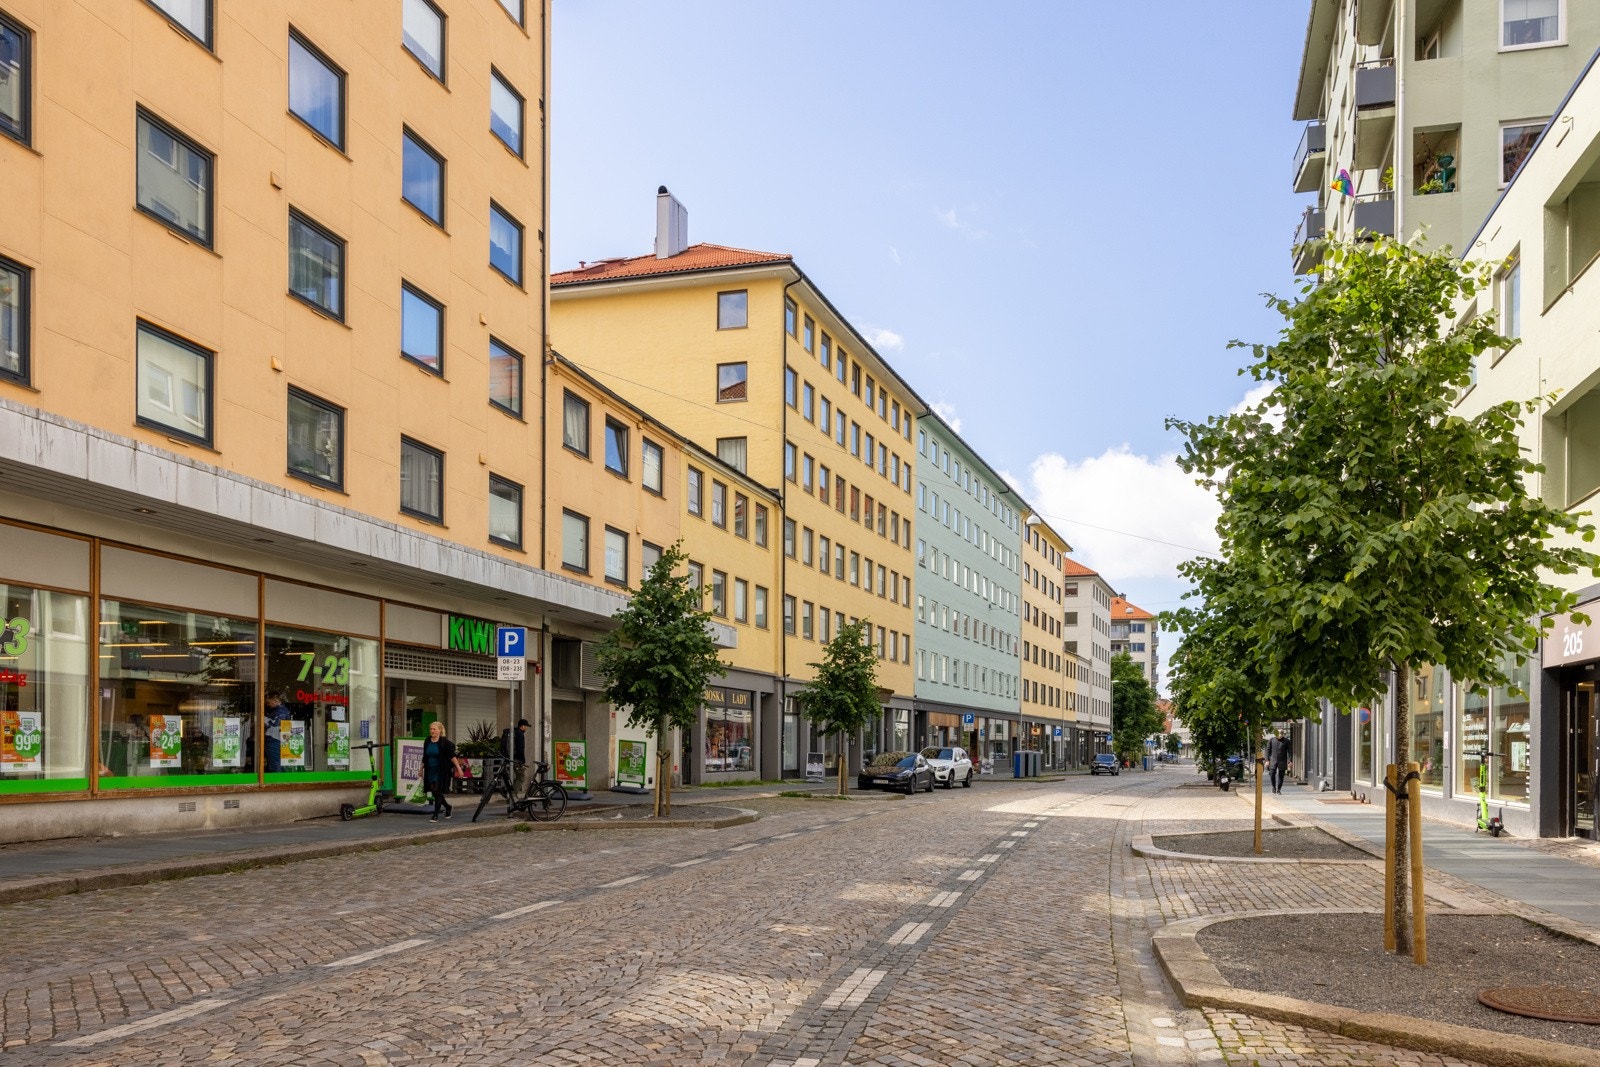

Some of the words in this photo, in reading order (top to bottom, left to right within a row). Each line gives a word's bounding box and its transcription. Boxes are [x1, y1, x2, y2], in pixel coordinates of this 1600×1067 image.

[449, 615, 495, 655] KIWI
[504, 631, 519, 654] P
[1563, 630, 1583, 657] 205
[732, 693, 748, 705] LADY
